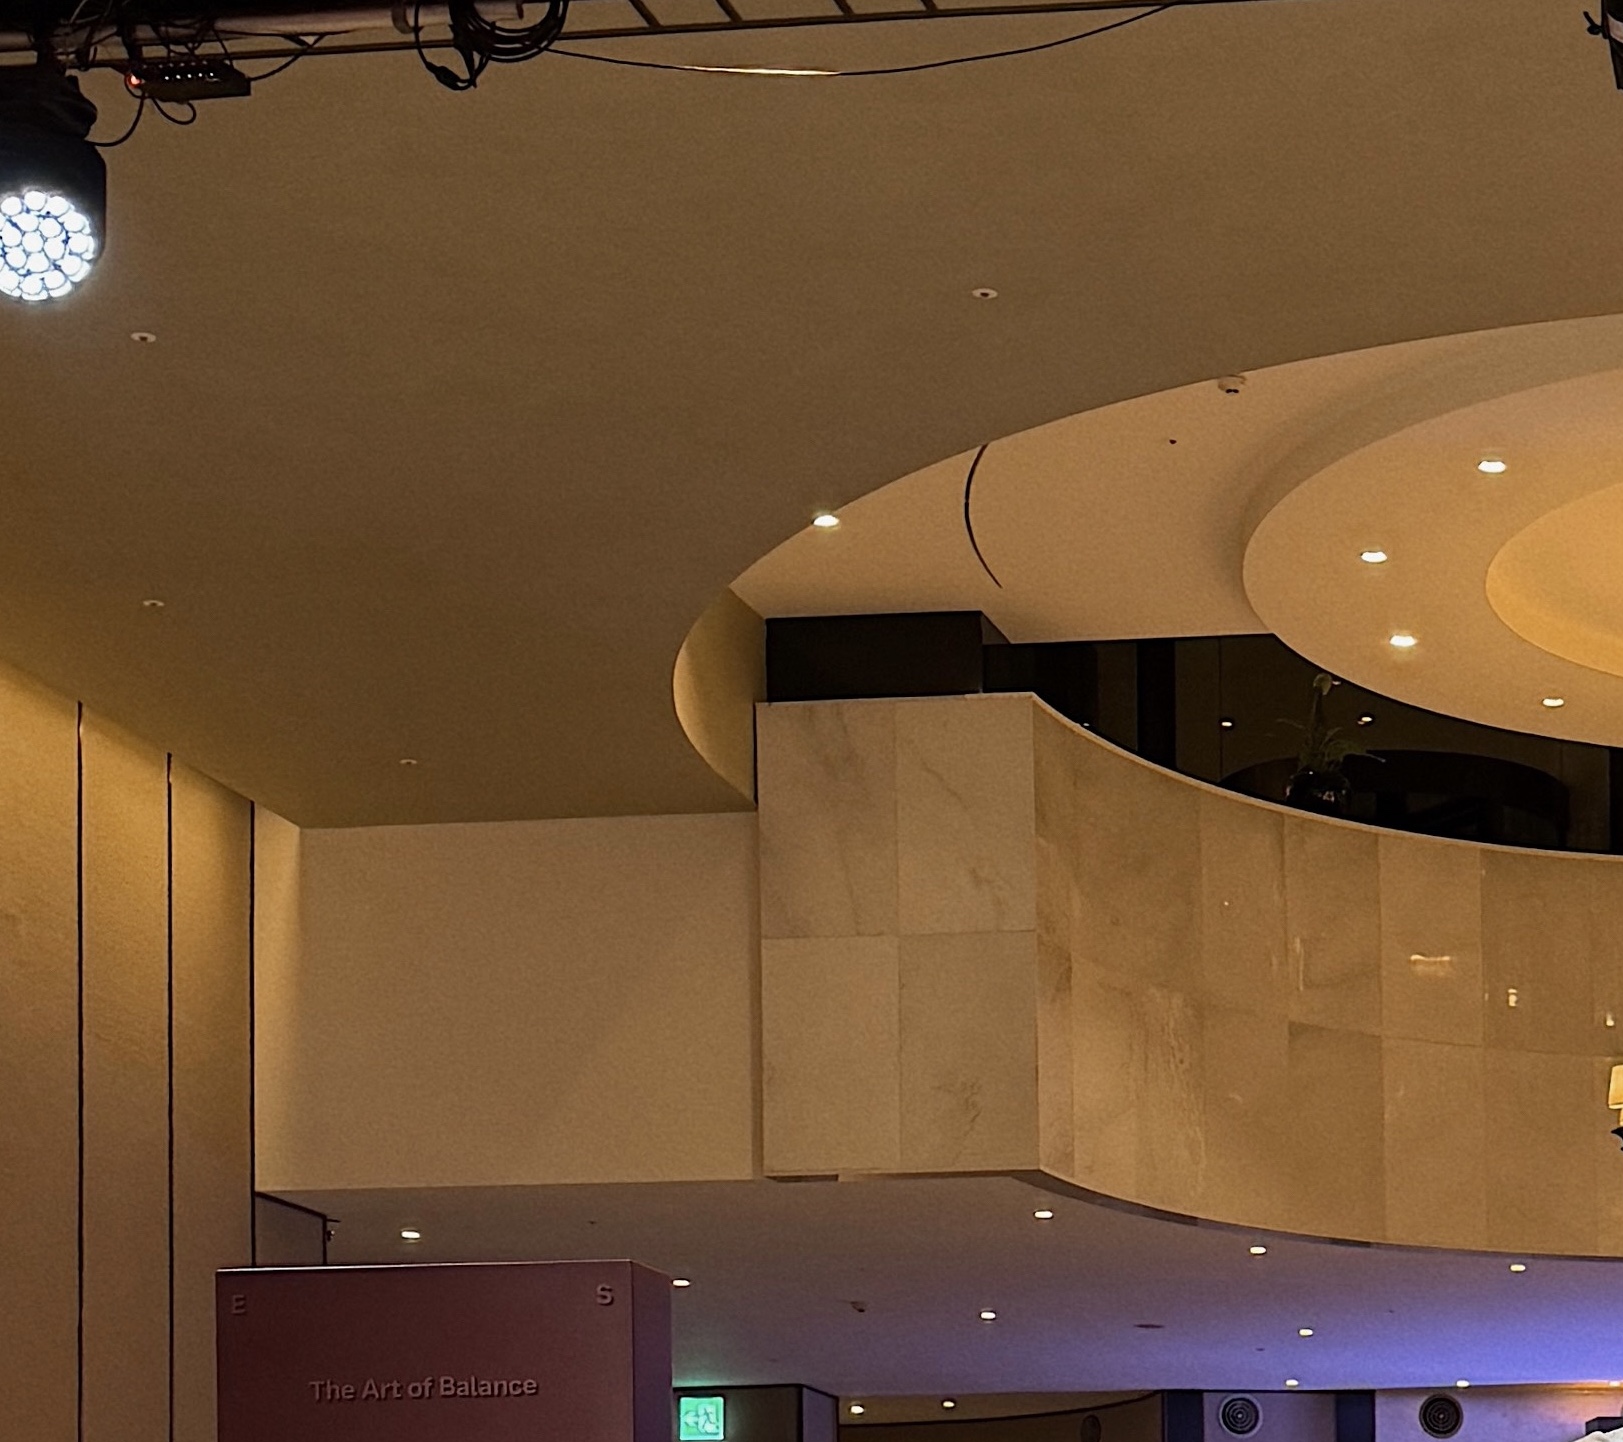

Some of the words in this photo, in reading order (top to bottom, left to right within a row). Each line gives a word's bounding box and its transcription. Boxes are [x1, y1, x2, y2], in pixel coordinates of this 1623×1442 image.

[231, 1294, 246, 1315] E
[596, 1284, 613, 1305] S
[308, 1379, 355, 1400] The
[361, 1378, 402, 1400] Art
[408, 1377, 433, 1398] of
[440, 1375, 538, 1397] Balance
